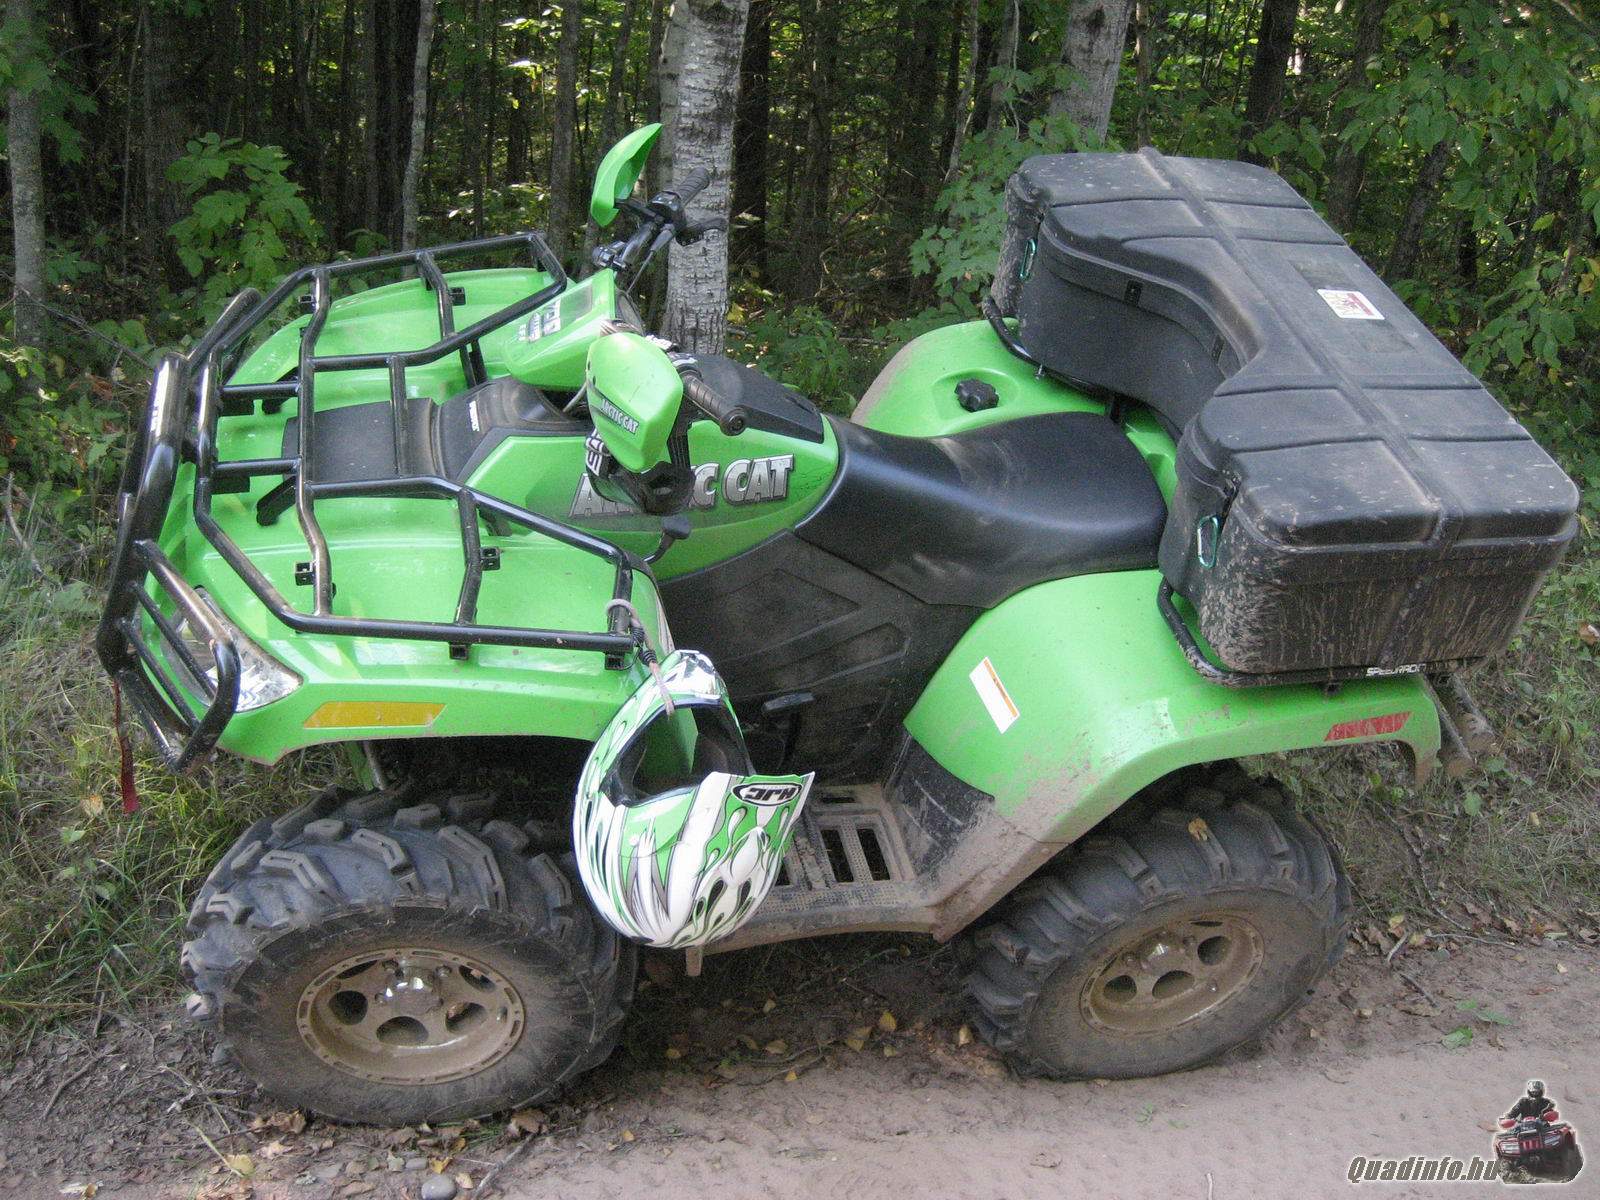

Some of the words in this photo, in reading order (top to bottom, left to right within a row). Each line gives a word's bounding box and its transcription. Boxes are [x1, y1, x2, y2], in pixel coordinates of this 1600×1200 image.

[623, 416, 639, 433] CAT
[722, 454, 794, 504] CAT
[744, 787, 797, 801] HJC
